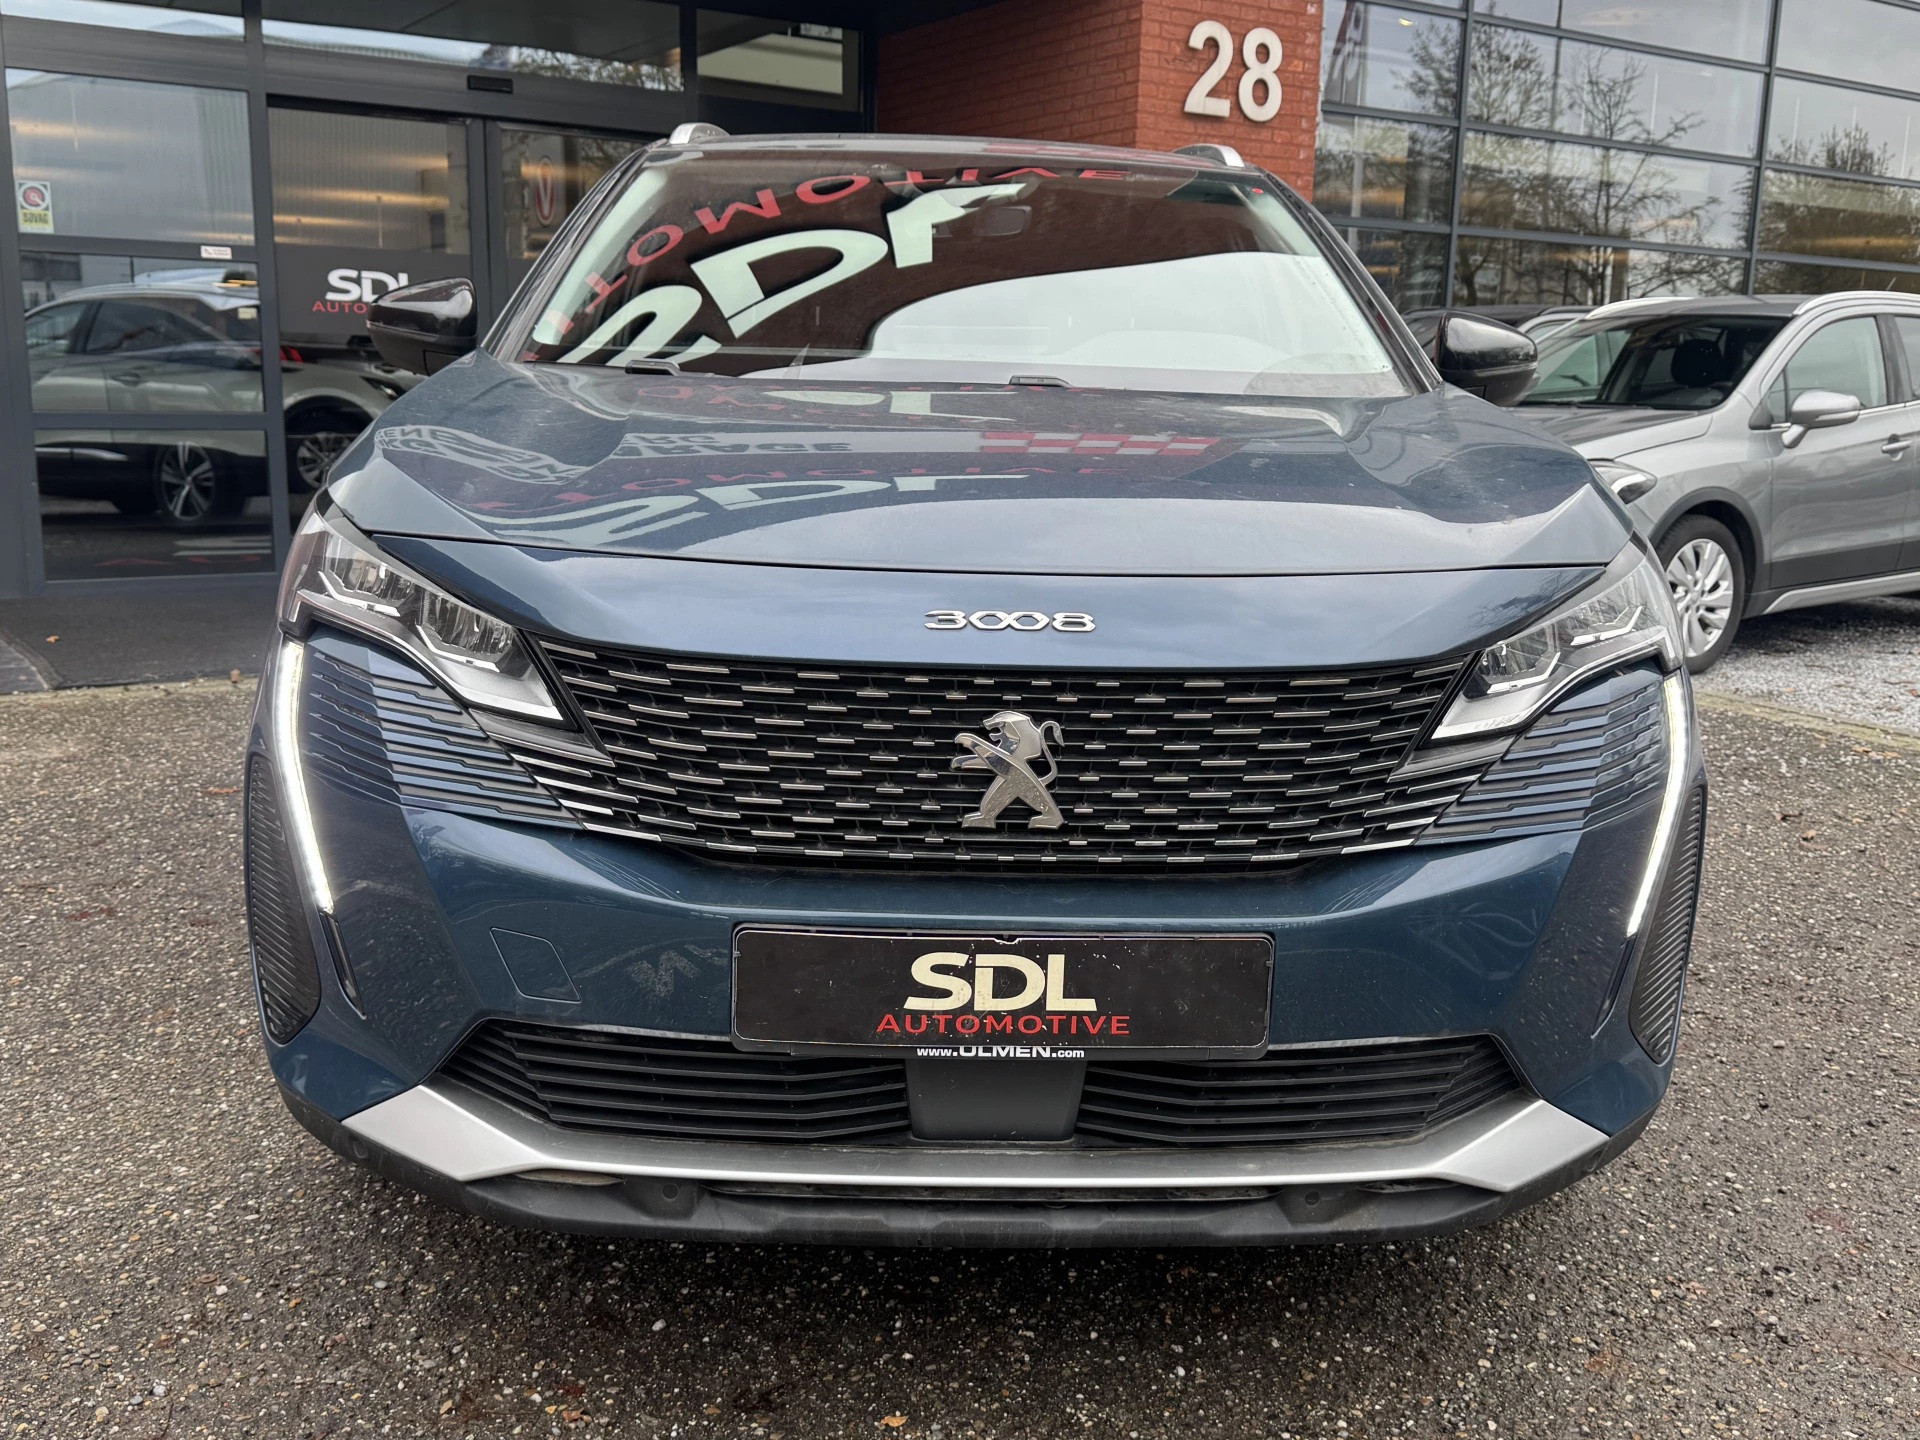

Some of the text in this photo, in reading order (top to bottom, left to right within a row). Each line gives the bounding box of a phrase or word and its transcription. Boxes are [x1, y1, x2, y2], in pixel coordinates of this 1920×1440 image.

[1183, 19, 1283, 122] 28
[312, 301, 368, 314] AUTO
[924, 610, 1096, 632] 3008
[903, 952, 1097, 1012] SDL
[876, 1013, 1130, 1036] AUTOMOTIVE
